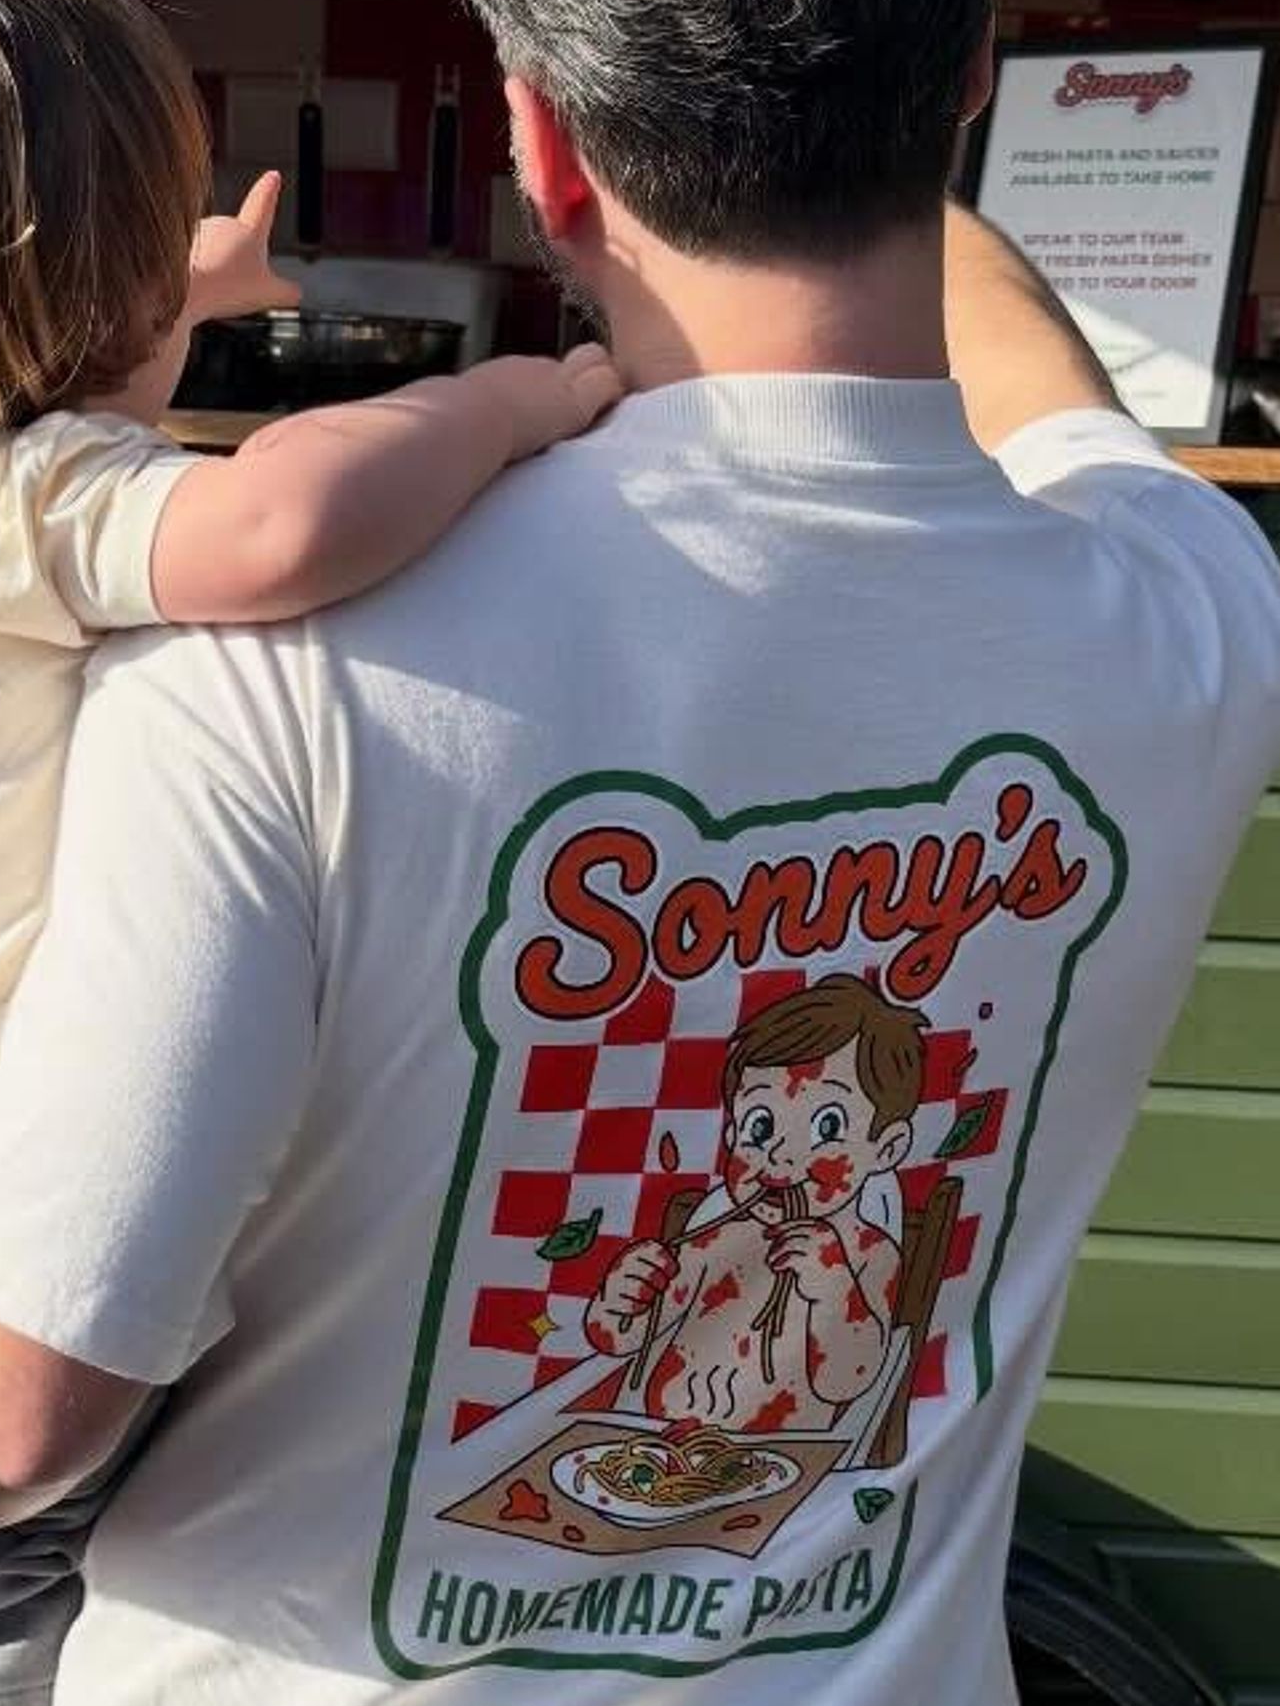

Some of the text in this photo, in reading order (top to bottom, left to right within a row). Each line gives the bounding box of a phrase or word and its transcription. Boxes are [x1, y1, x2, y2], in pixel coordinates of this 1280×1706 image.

[1054, 61, 1193, 115] Sonny's
[1011, 146, 1220, 164] FRESH PASTA AND SAUCES
[1010, 169, 1216, 186] AVAILABLE TO TAKE HOME
[1023, 234, 1184, 246] SPEAK TO OUR TEAM
[1045, 255, 1097, 268] FRESH
[1100, 255, 1149, 266] PASTA
[1077, 278, 1100, 290] TO
[1103, 277, 1146, 289] YOUR
[1150, 277, 1196, 289] DOOR
[514, 782, 1088, 1022] Sonny's
[416, 1569, 734, 1646] HOMEMADE
